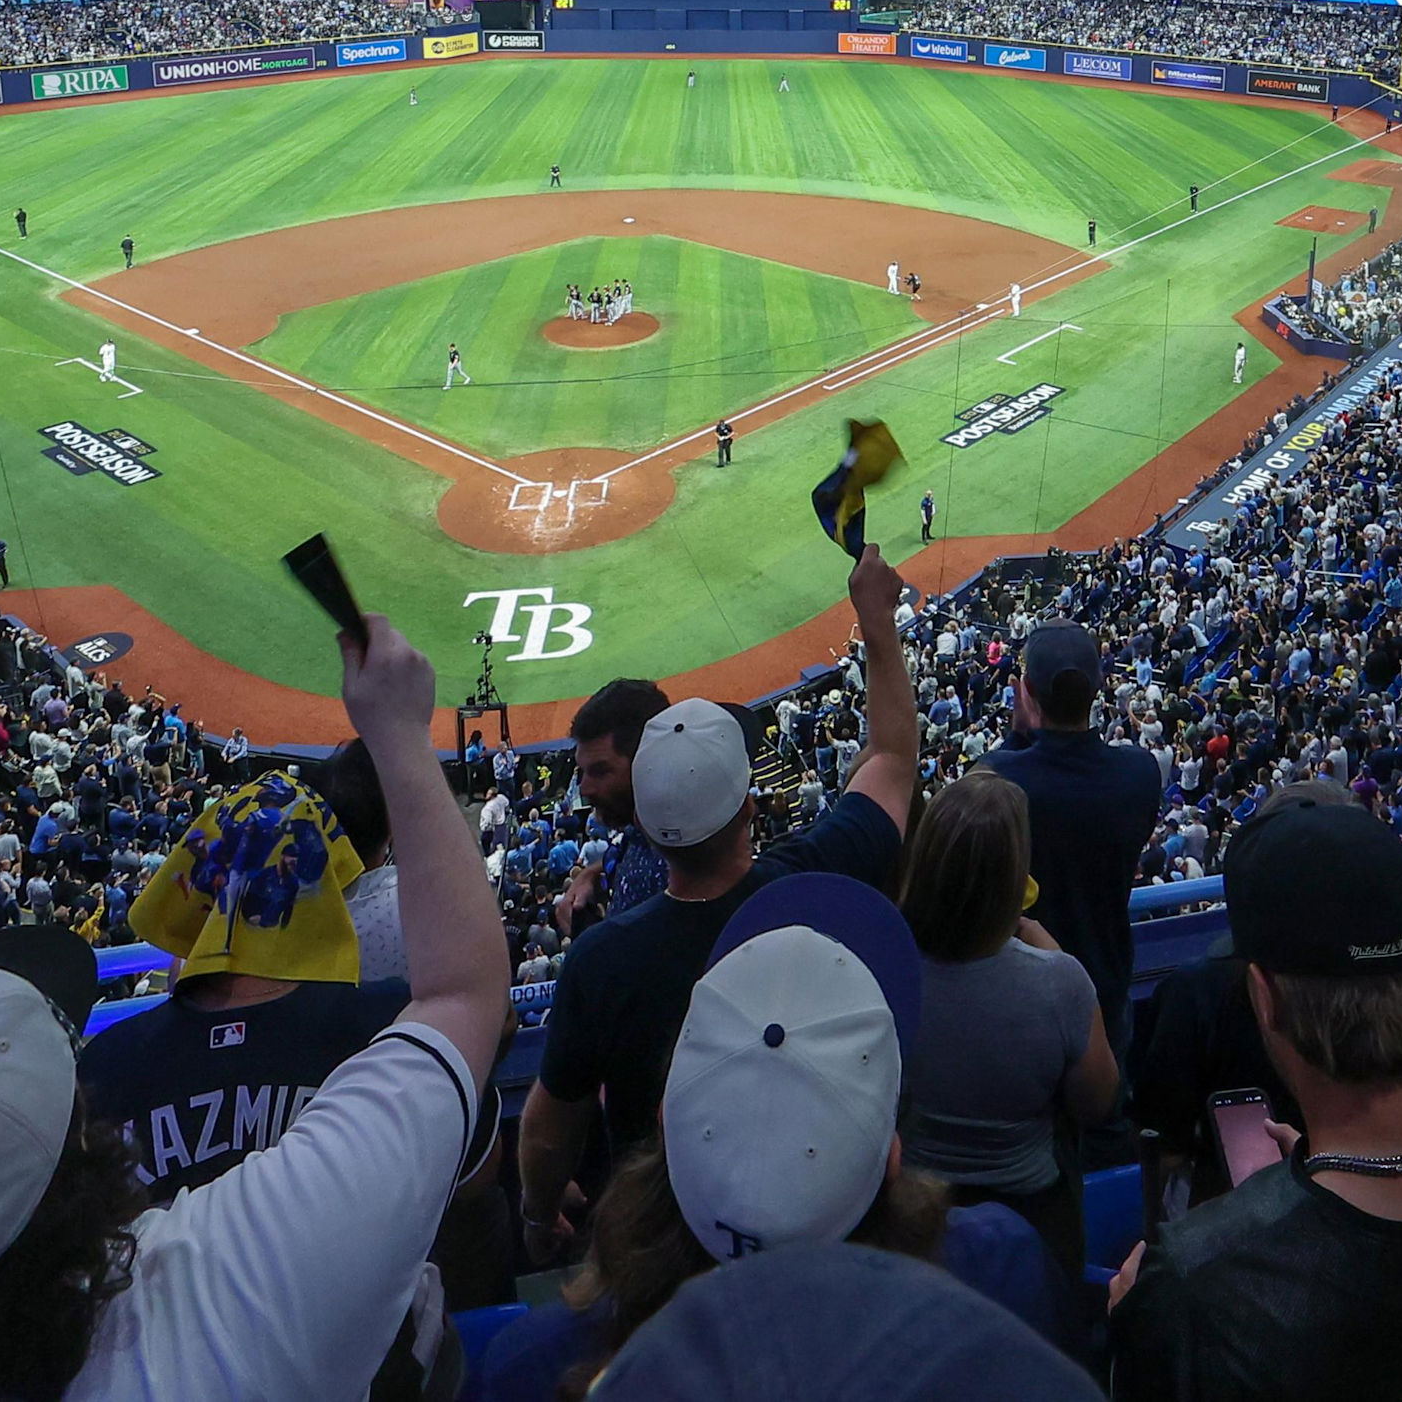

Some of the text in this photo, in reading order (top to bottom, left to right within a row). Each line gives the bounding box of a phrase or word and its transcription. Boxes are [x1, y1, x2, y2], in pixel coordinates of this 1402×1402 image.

[847, 35, 889, 45] ORLANDO
[342, 46, 396, 60] Spectrum
[851, 44, 885, 52] HEALTH
[931, 43, 962, 57] Webull
[262, 56, 309, 71] MORTGAGE
[1073, 57, 1121, 72] LECOM
[63, 67, 122, 93] RIPA
[1167, 69, 1222, 82] MicroLumen
[1254, 79, 1321, 94] AMERANT BANK
[945, 384, 1061, 447] POSTSEASON
[1222, 467, 1273, 505] HOME
[1265, 451, 1295, 471] OF
[1282, 422, 1328, 452] YOUR
[1315, 392, 1357, 424] TAMPA
[1352, 375, 1379, 400] BAY
[44, 422, 155, 485] POSTSEASON
[462, 586, 594, 662] TB
[75, 641, 111, 663] ALCS
[1349, 943, 1391, 957] Mitchell
[512, 986, 535, 1004] DO
[122, 1085, 320, 1186] AZMI
